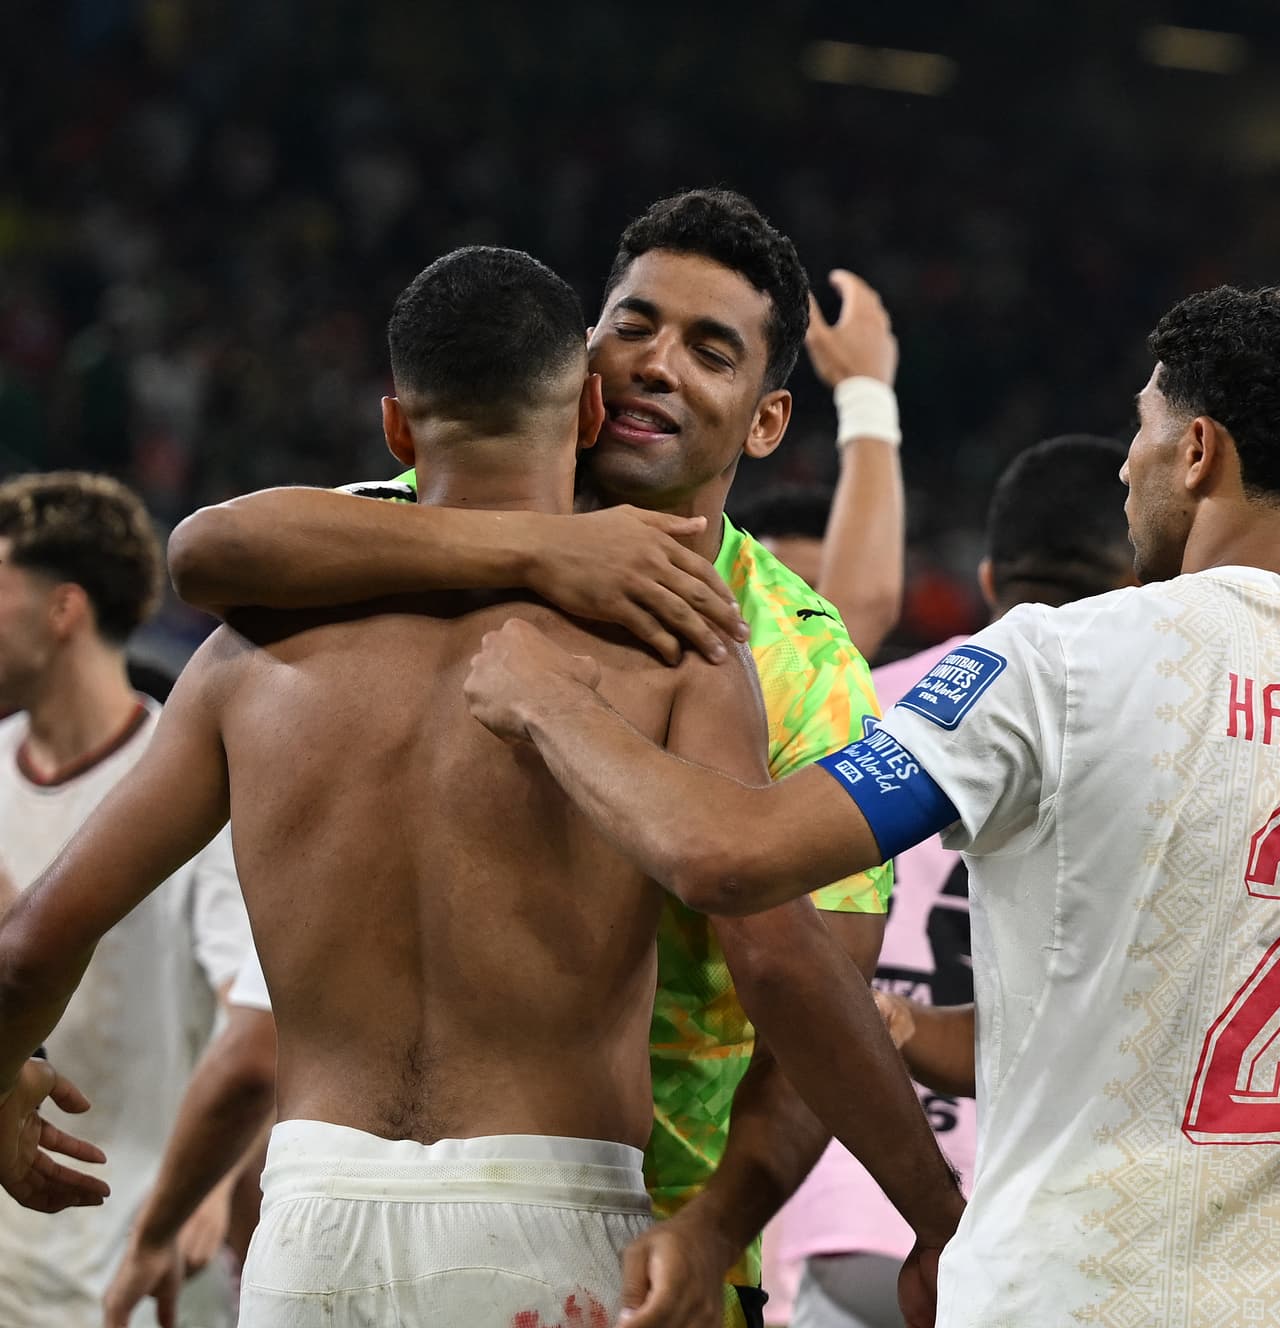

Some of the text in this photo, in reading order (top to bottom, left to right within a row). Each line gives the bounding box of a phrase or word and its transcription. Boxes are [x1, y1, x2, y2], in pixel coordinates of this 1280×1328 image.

[929, 664, 977, 689] UNITES
[941, 654, 984, 675] FOOTBALL
[918, 692, 938, 704] FIFA
[930, 680, 967, 704] World
[863, 730, 919, 780] UNITES
[838, 762, 859, 781] FIFA
[855, 751, 901, 794] World
